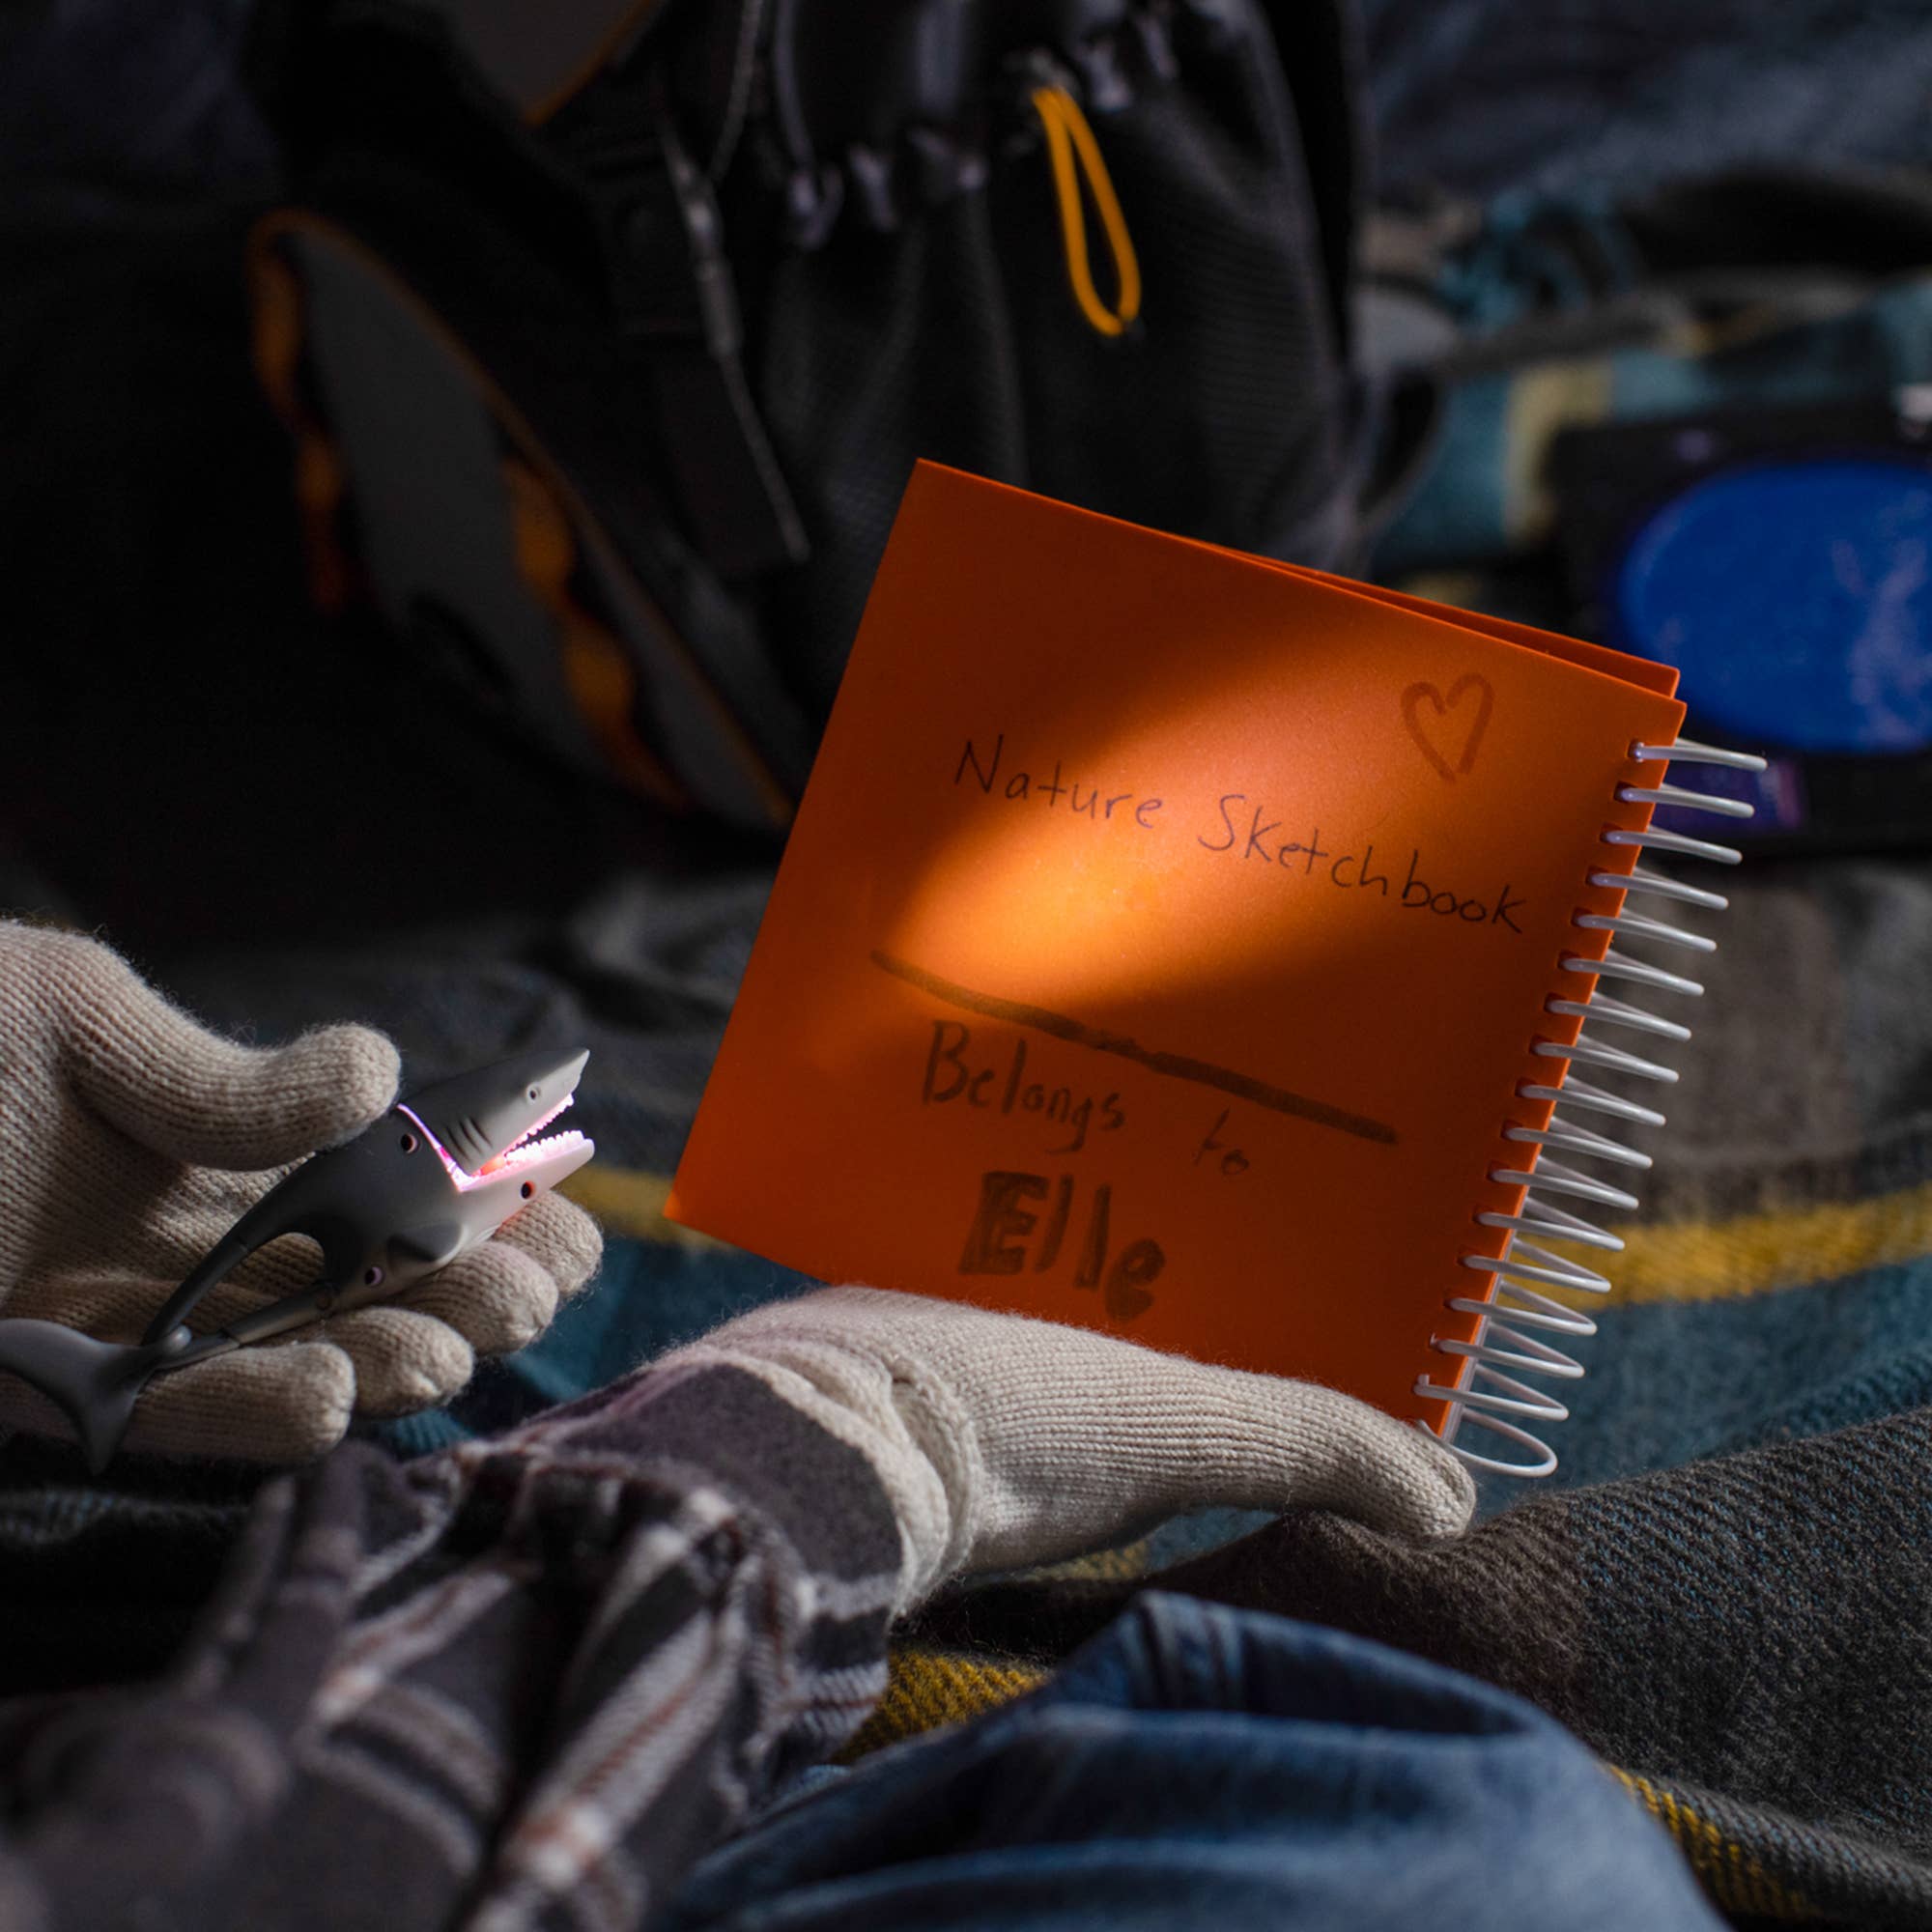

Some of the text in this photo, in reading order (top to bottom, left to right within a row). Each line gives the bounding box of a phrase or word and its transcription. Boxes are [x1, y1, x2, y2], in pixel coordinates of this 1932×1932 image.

[954, 733, 1528, 934] Nature Sketchbook
[922, 1019, 1250, 1176] Belongs to
[958, 1170, 1167, 1323] Elle
